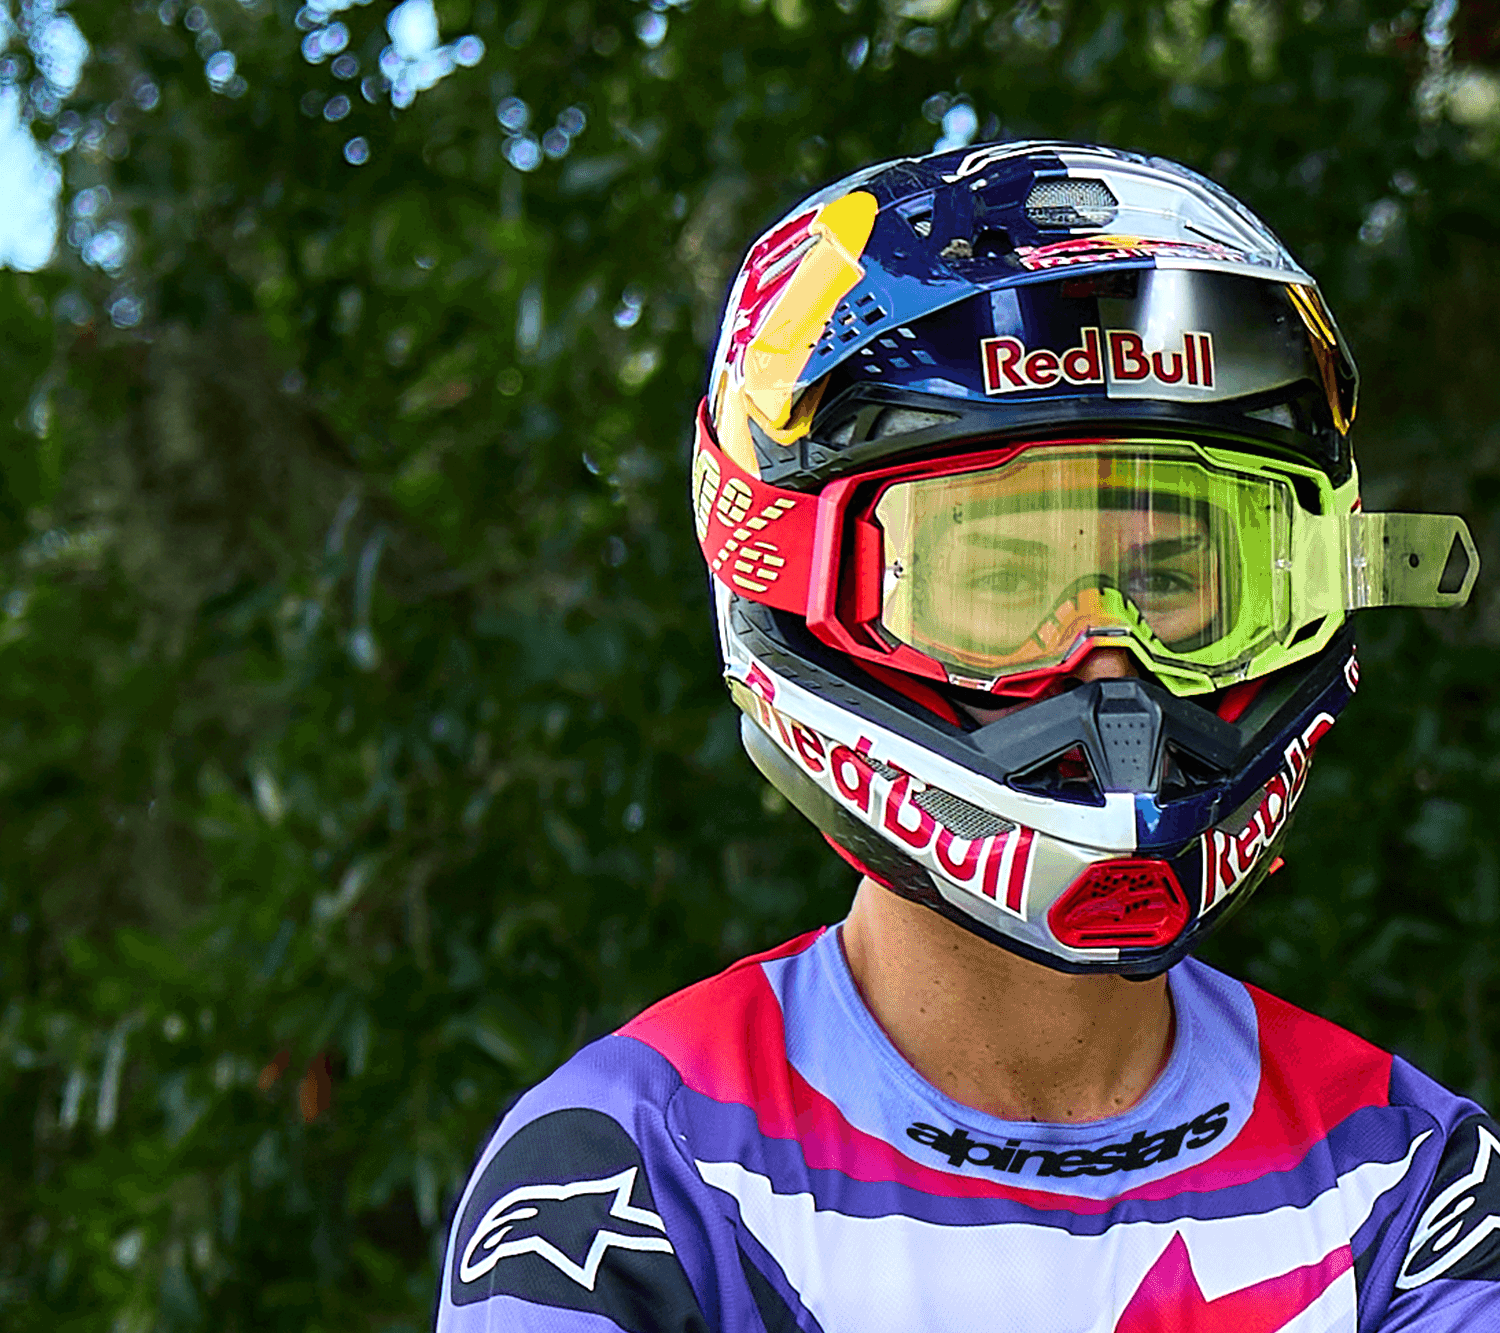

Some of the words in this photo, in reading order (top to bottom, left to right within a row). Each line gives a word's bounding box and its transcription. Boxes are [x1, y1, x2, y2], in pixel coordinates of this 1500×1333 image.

[981, 328, 1104, 394] Red
[1105, 330, 1216, 392] Bull
[905, 1101, 1231, 1178] alpinestars
